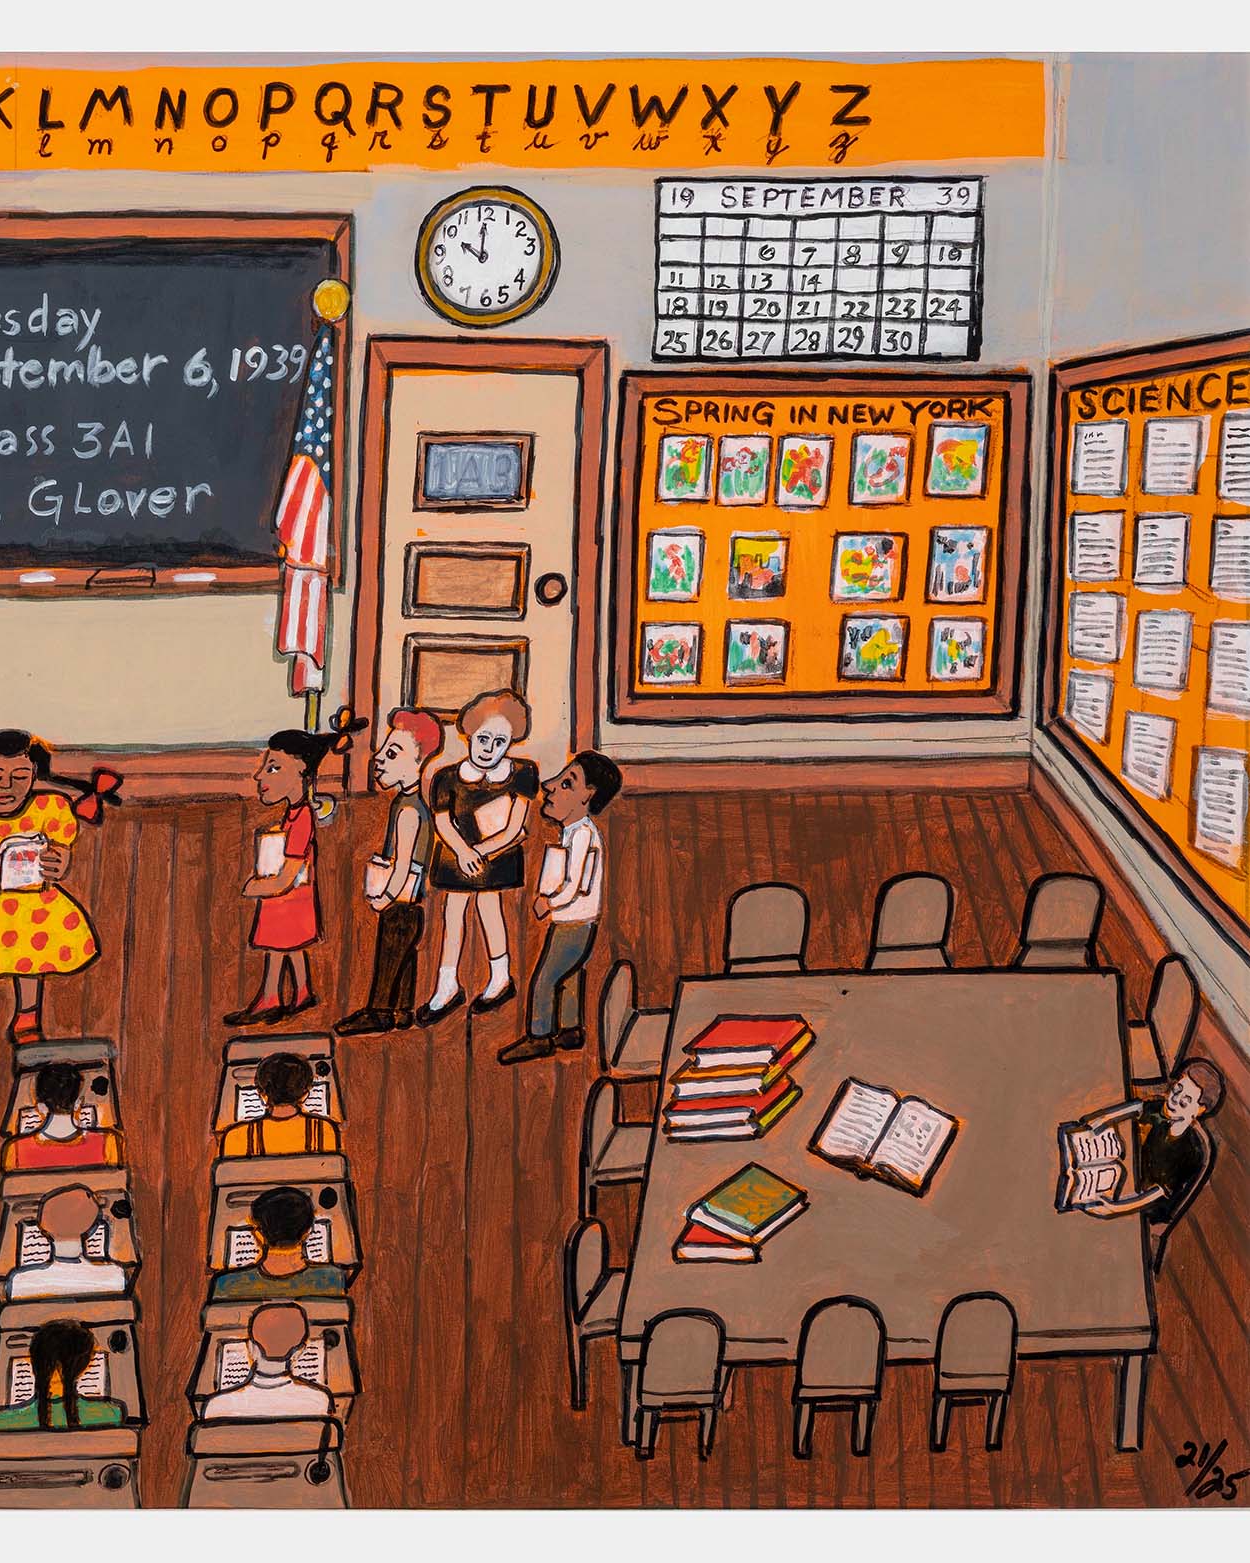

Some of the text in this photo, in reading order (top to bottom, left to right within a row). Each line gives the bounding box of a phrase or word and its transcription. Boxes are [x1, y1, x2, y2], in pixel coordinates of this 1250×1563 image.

[37, 89, 65, 131] L
[79, 85, 133, 131] M
[155, 88, 186, 132] N
[203, 88, 238, 128] O
[258, 82, 295, 131] P
[314, 82, 356, 137] Q
[366, 82, 403, 133] R
[422, 85, 451, 131] S
[472, 84, 511, 127] T
[524, 85, 557, 130] U
[574, 83, 616, 128] V
[629, 84, 688, 129] W
[701, 84, 738, 131] X
[764, 81, 801, 136] Y
[829, 84, 871, 126] Z
[39, 133, 52, 157] l
[88, 139, 112, 155] m
[154, 138, 173, 154] n
[212, 136, 227, 152] o
[262, 133, 280, 160] p
[321, 132, 338, 163] q
[477, 131, 490, 153] t
[525, 129, 553, 150] u
[579, 132, 609, 150] v
[633, 130, 669, 150] w
[703, 130, 721, 155] x
[766, 134, 789, 165] y
[672, 186, 969, 211] 19 SEPTEMBER 39
[457, 209, 469, 225] 11
[477, 205, 496, 222] 12
[505, 209, 510, 226] 1
[443, 224, 458, 239] 10
[514, 220, 527, 238] 2
[433, 243, 446, 265] 9
[523, 236, 536, 256] 3
[802, 247, 817, 264] 7
[842, 245, 861, 265] 8
[890, 243, 913, 264] 9
[442, 264, 454, 287] 8
[513, 267, 526, 291] 4
[671, 272, 822, 290] 11 12 13 14
[458, 285, 472, 305] 7
[479, 288, 493, 307] 6
[497, 285, 510, 304] 5
[665, 297, 962, 317] 18 19 20 21 22 23 24
[661, 326, 912, 353] 25 26 27 28 29 30
[184, 348, 218, 398] 6,
[230, 345, 307, 383] 1939
[1077, 369, 1250, 419] SCIENCE
[653, 397, 995, 428] SPRING IN NEW YORK
